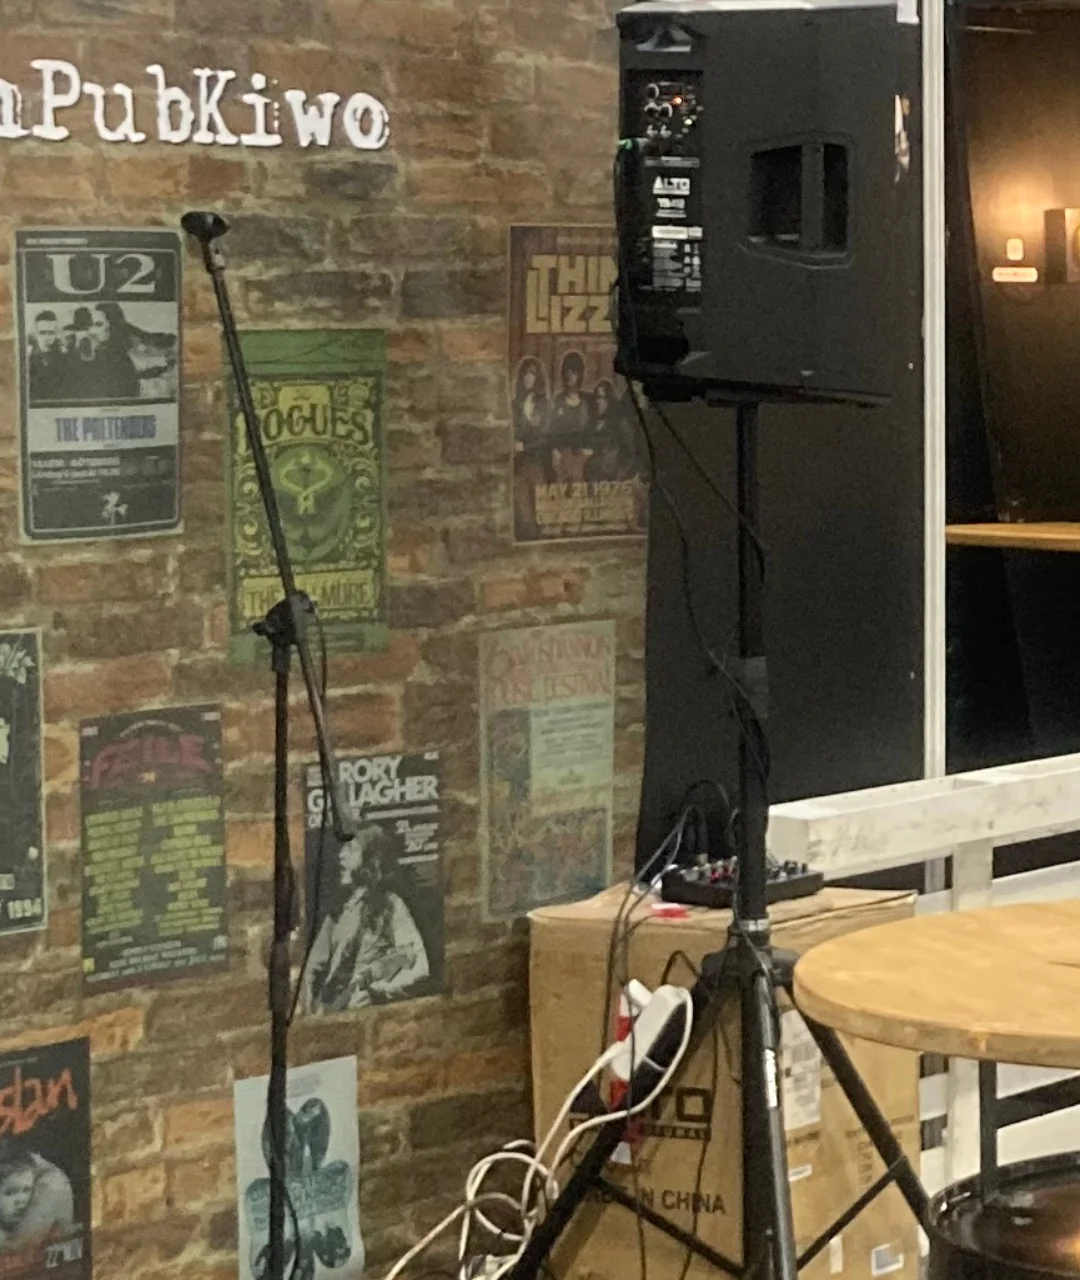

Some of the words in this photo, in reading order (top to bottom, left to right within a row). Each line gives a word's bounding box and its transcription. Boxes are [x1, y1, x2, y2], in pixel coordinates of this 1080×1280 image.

[46, 253, 156, 295] U2
[526, 269, 613, 333] LIZZ
[245, 403, 370, 447] OGUES
[338, 755, 403, 784] RORY
[307, 775, 440, 813] GLAGHER
